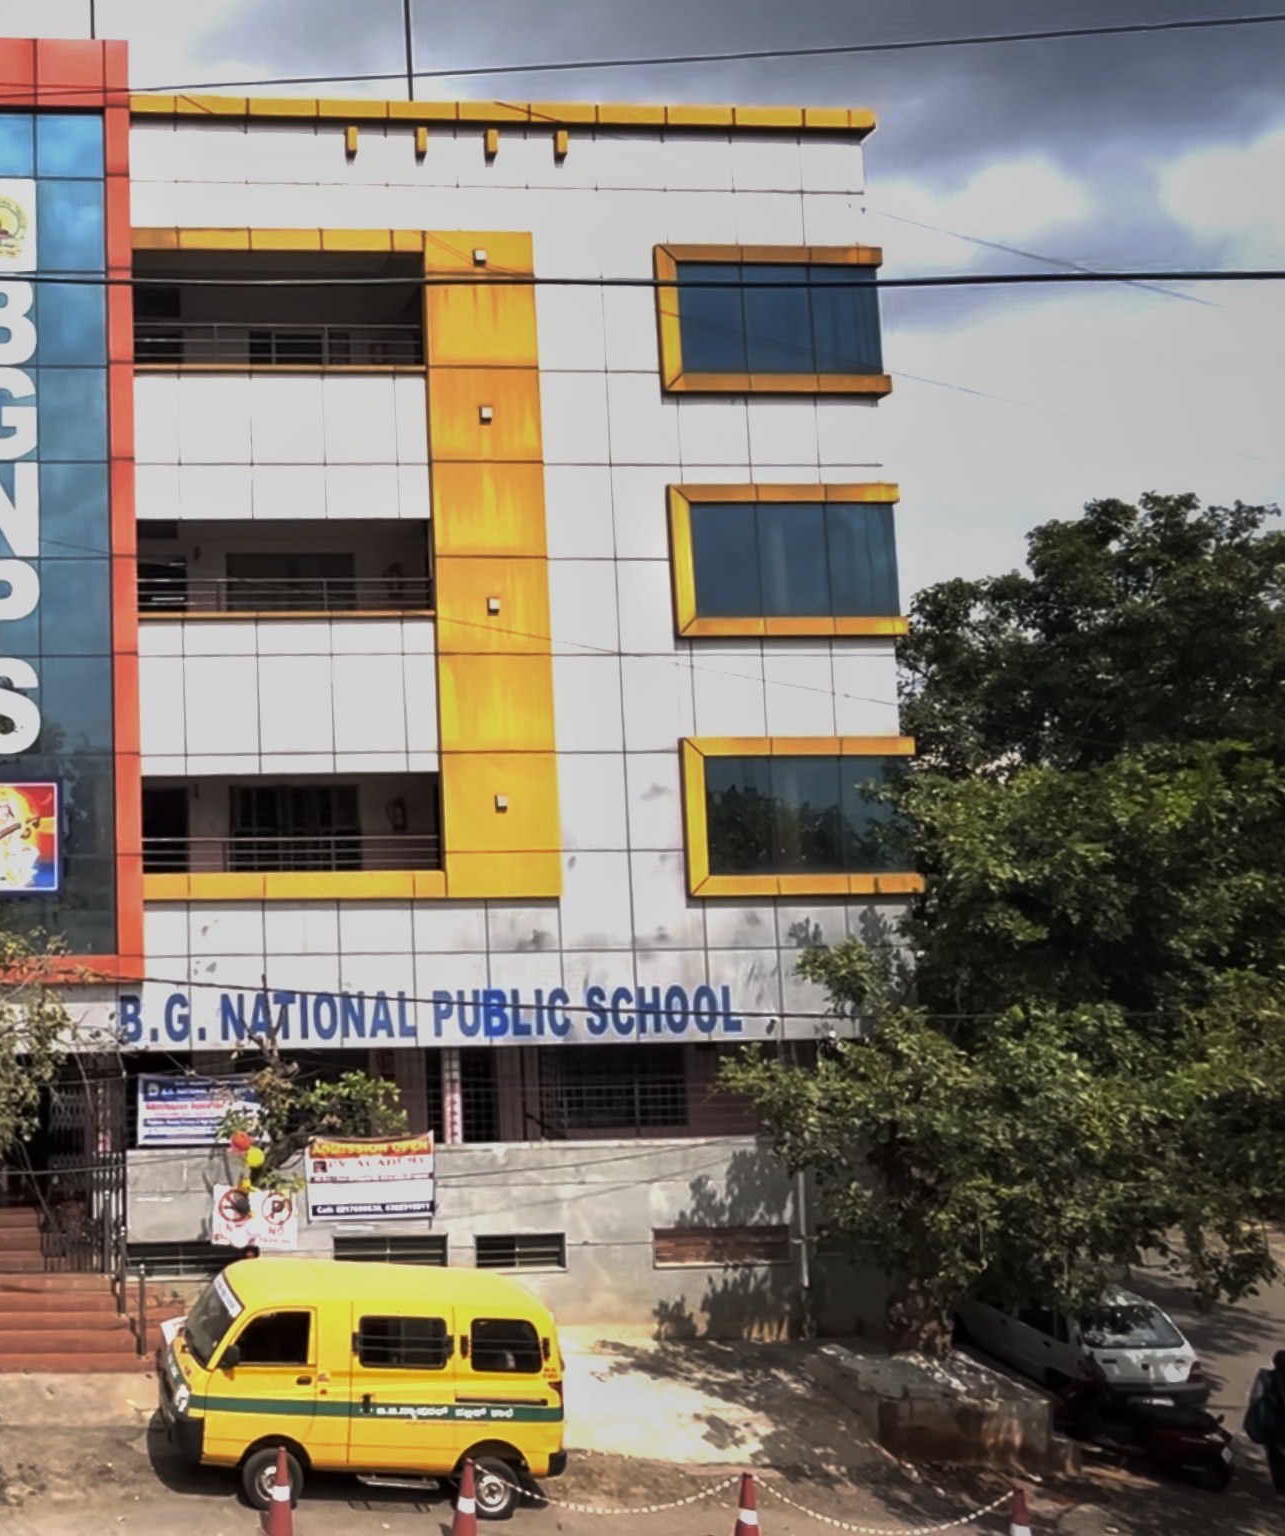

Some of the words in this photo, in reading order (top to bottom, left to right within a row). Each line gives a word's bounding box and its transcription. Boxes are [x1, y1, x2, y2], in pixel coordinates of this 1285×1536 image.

[220, 989, 416, 1040] NATIONAL
[432, 987, 571, 1037] PUBLIC
[585, 984, 743, 1035] SCHOOL
[392, 1138, 429, 1152] OPEN
